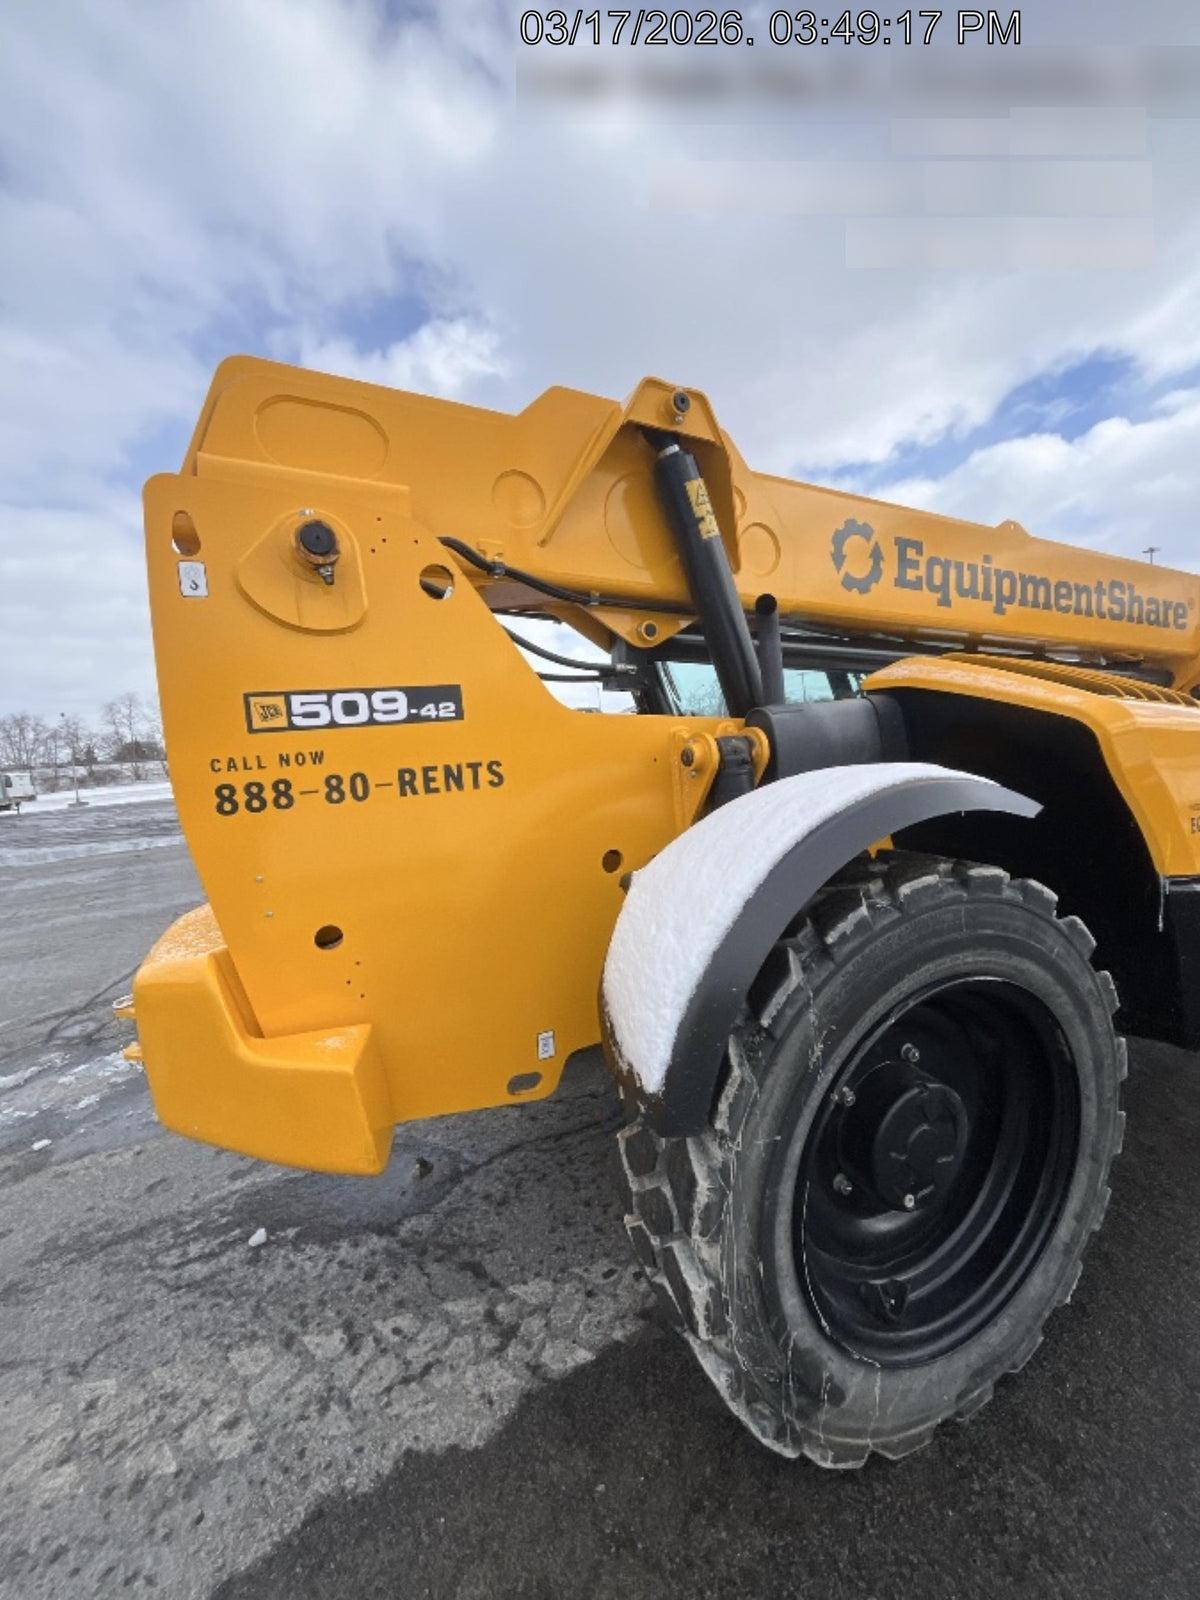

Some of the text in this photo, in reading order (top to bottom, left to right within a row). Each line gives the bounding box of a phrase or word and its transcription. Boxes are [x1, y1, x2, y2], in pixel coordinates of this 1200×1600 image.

[894, 536, 1189, 630] EquipmentShare
[210, 750, 325, 773] CALL NOW
[214, 760, 505, 816] 888-80-RENTS
